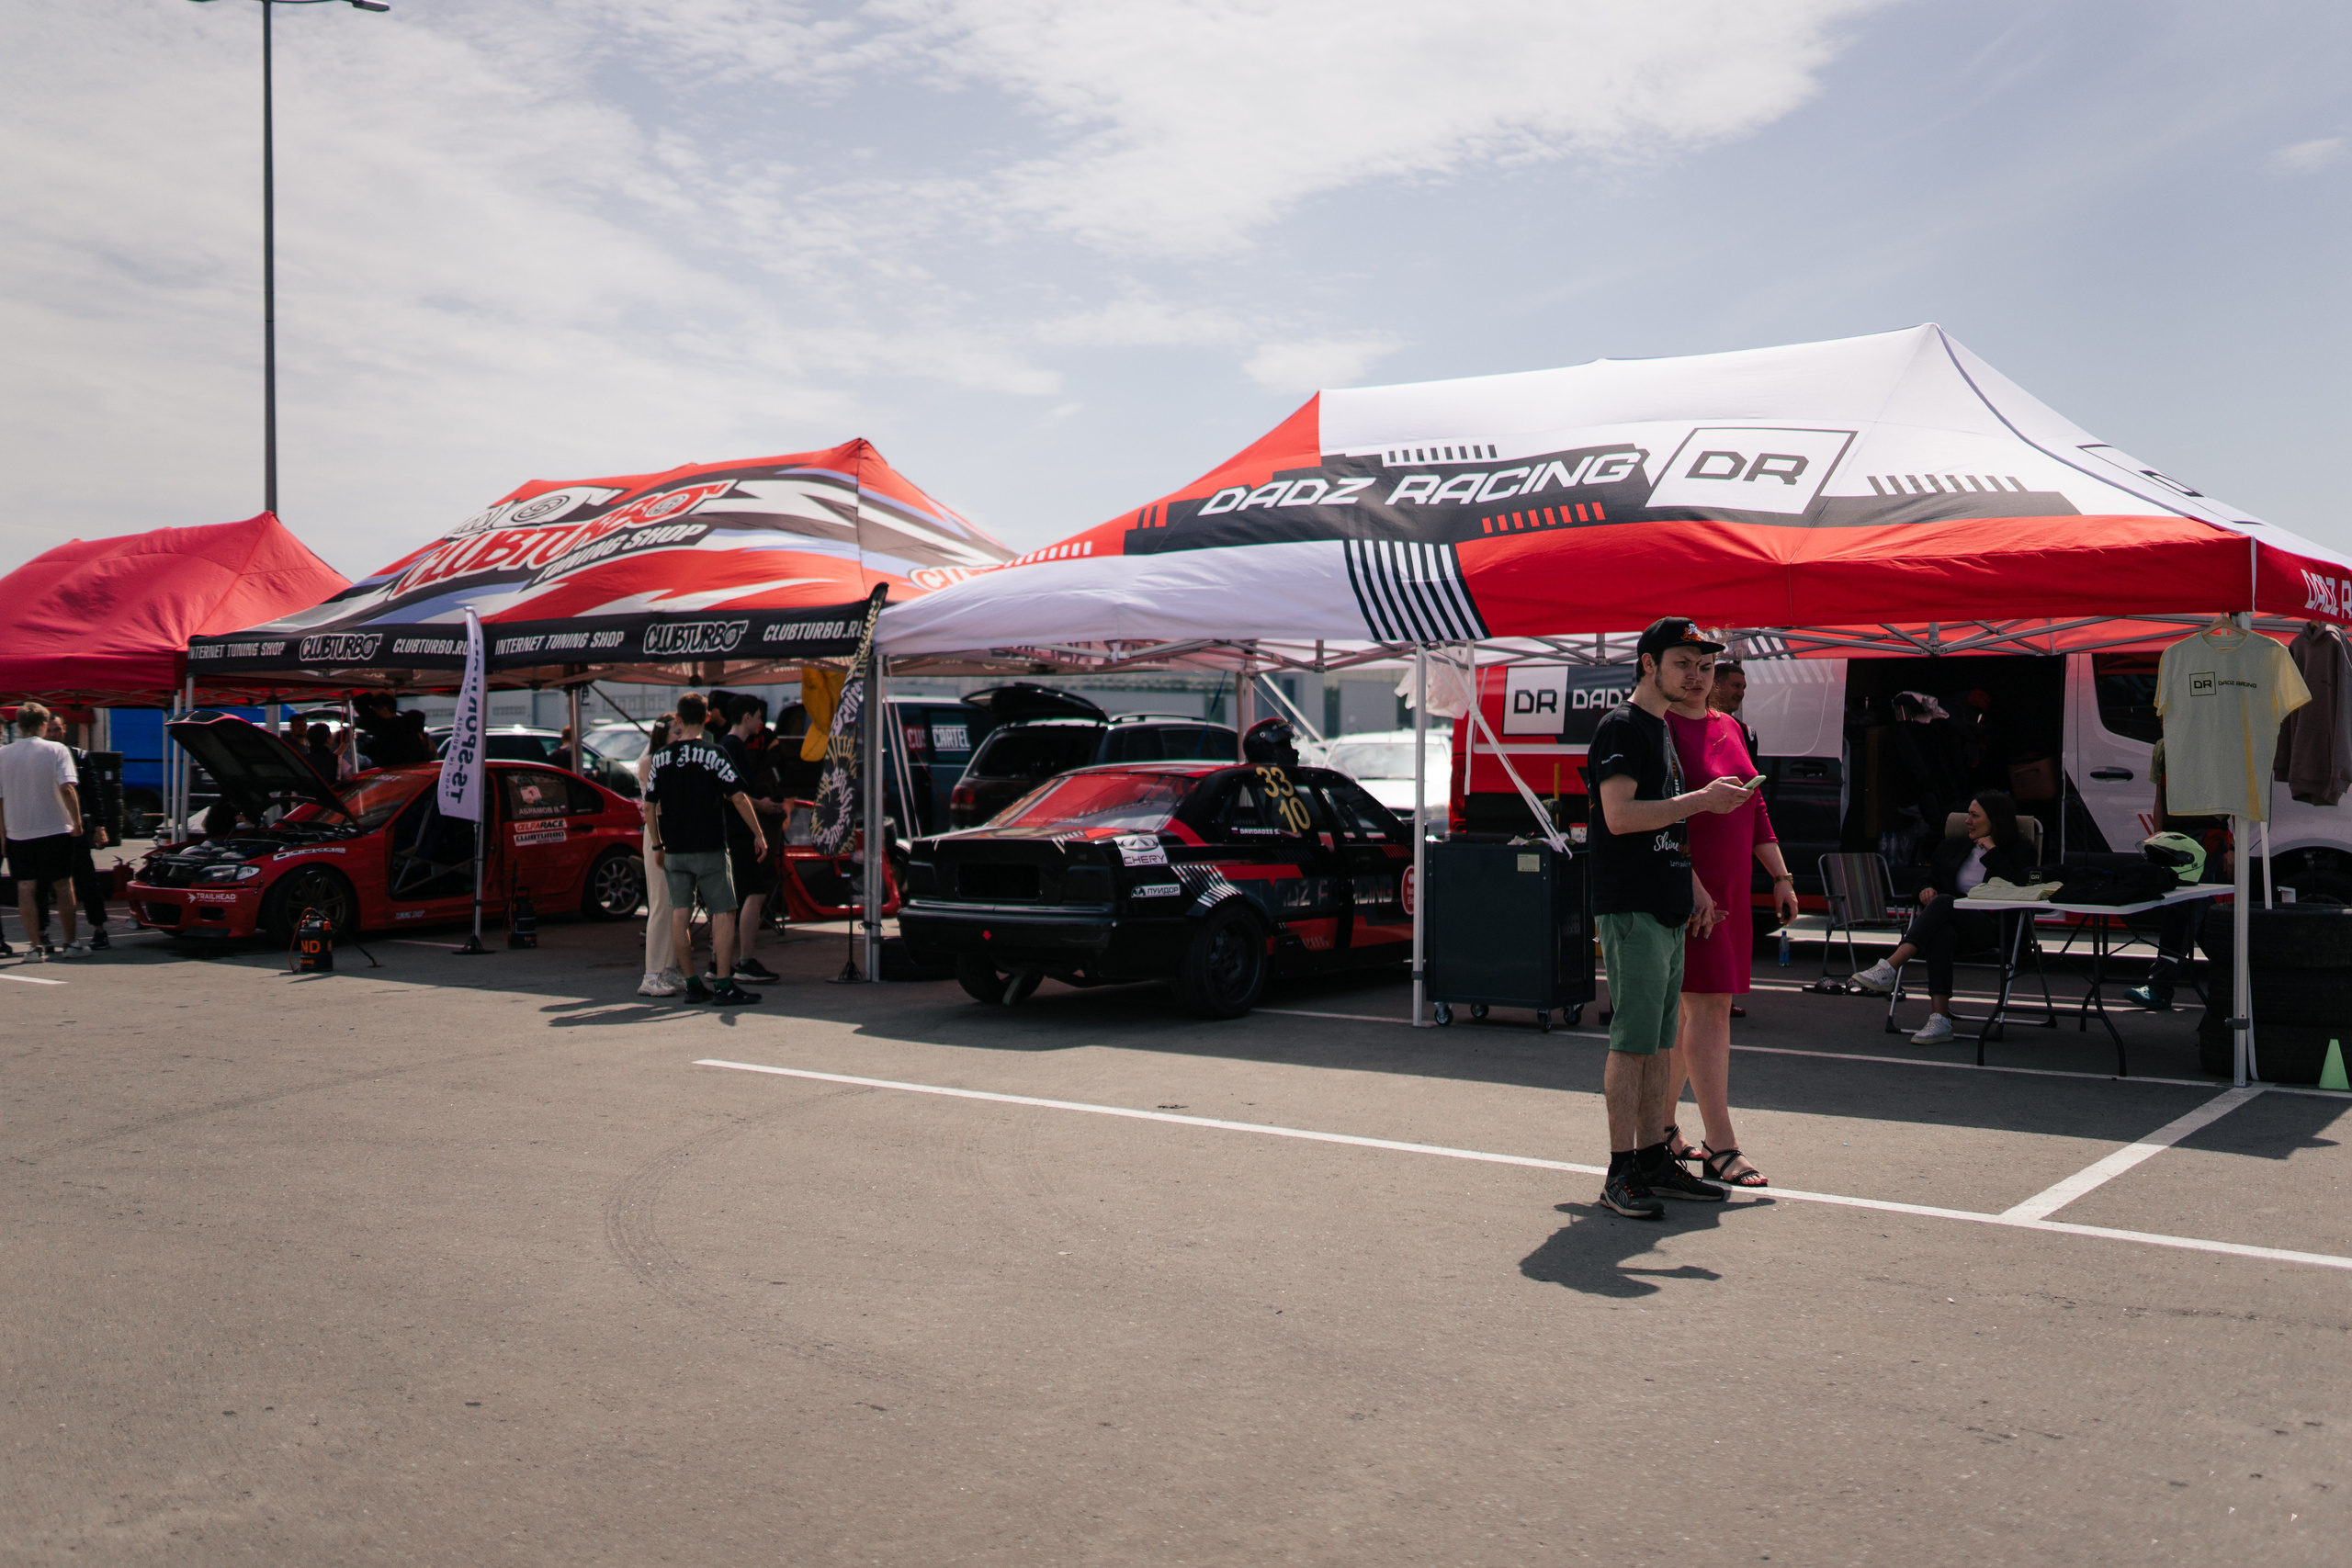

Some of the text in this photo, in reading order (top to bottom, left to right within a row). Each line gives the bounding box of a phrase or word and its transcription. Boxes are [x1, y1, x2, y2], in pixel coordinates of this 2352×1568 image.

[1685, 450, 1810, 486] DR
[1196, 451, 1643, 516] DADZ RACING
[626, 524, 709, 551] SHOP
[2300, 569, 2339, 616] DADZ
[300, 633, 383, 661] CLUBTURBO
[494, 630, 625, 656] INTERNET TUNING SHOP
[642, 619, 749, 655] CLUBTURBO
[187, 641, 286, 660] NTERNET TUNING SHOP
[2194, 680, 2212, 689] DR
[1514, 689, 1557, 714] DR
[1572, 688, 1632, 710] DAD
[932, 728, 971, 748] CARTEL
[676, 744, 738, 784] Angels
[1256, 766, 1295, 798] 33
[1278, 796, 1310, 833] 10
[1654, 831, 1679, 852] Shine
[1124, 854, 1165, 865] CHERY
[196, 892, 236, 900] TRAILHEAD
[1148, 886, 1179, 896] ЛУИДОР
